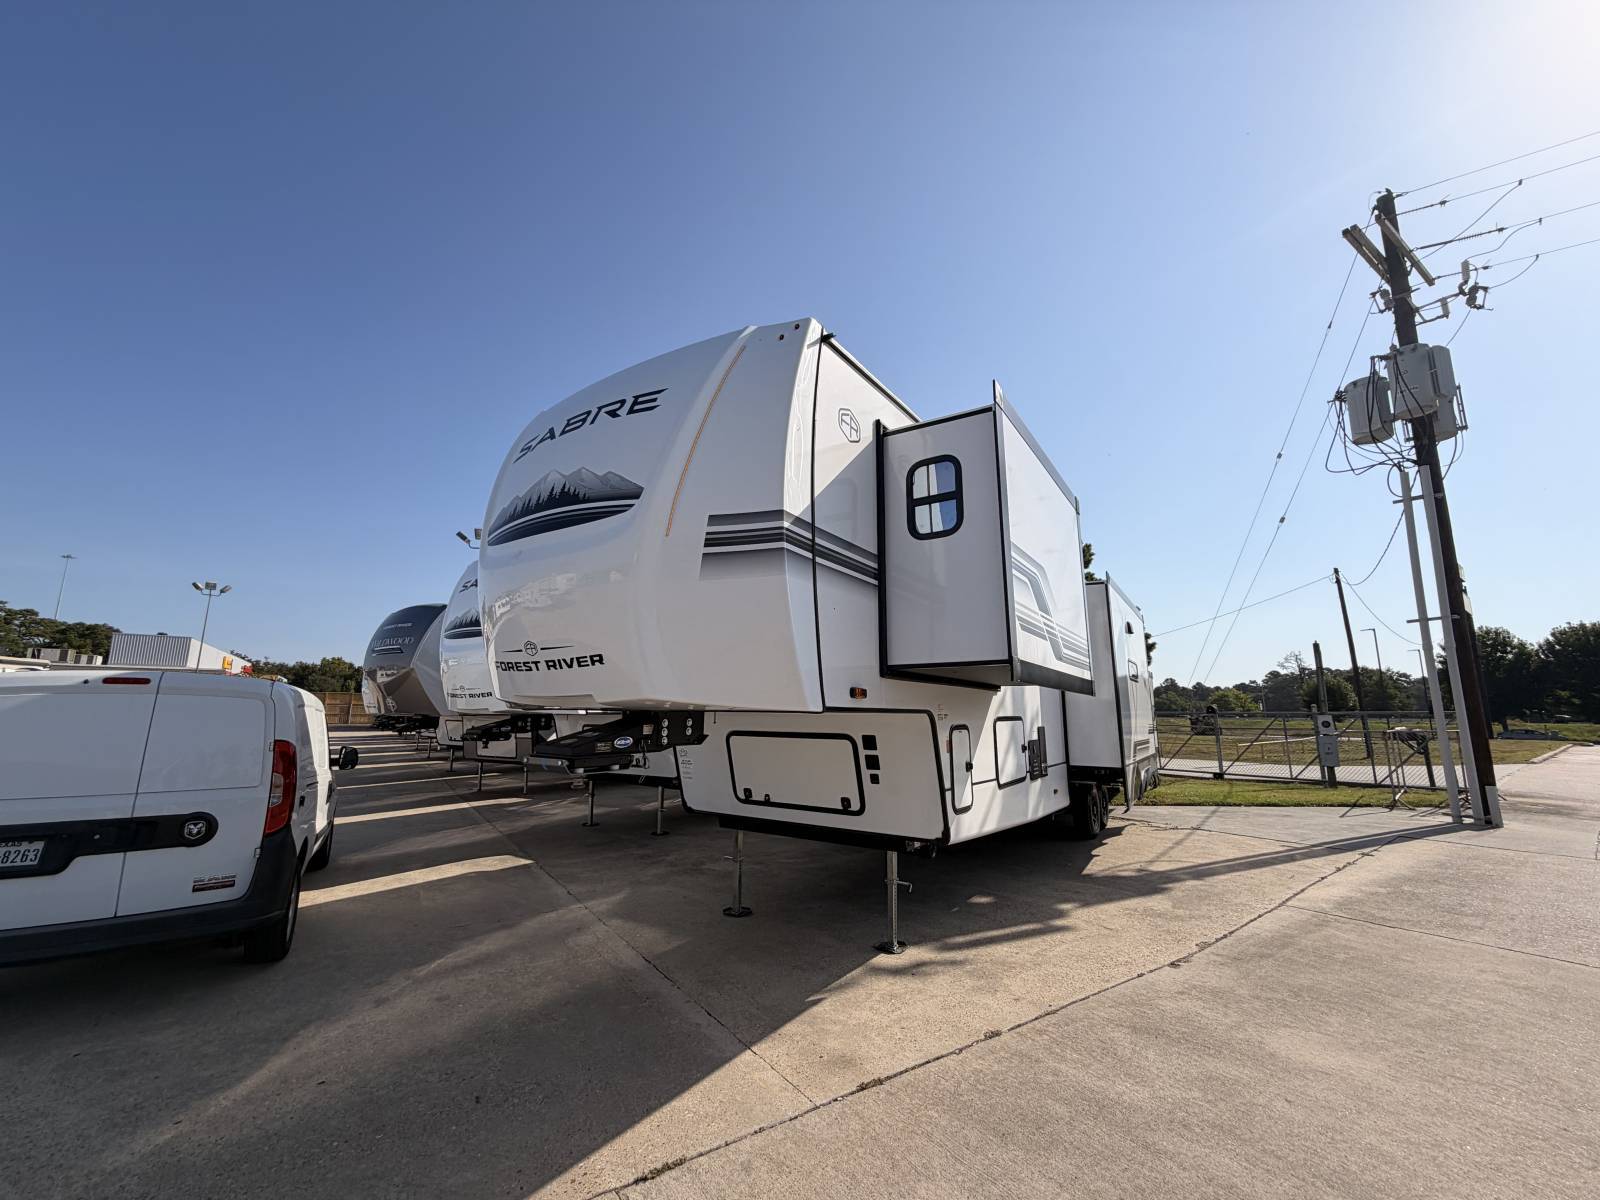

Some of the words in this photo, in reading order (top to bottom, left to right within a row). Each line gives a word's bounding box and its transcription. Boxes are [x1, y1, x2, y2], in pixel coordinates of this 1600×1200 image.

[513, 388, 669, 464] SABRE
[495, 660, 541, 672] FOREST
[543, 653, 605, 671] RIVER
[468, 691, 493, 699] RIVER
[1, 848, 40, 864] 8263
